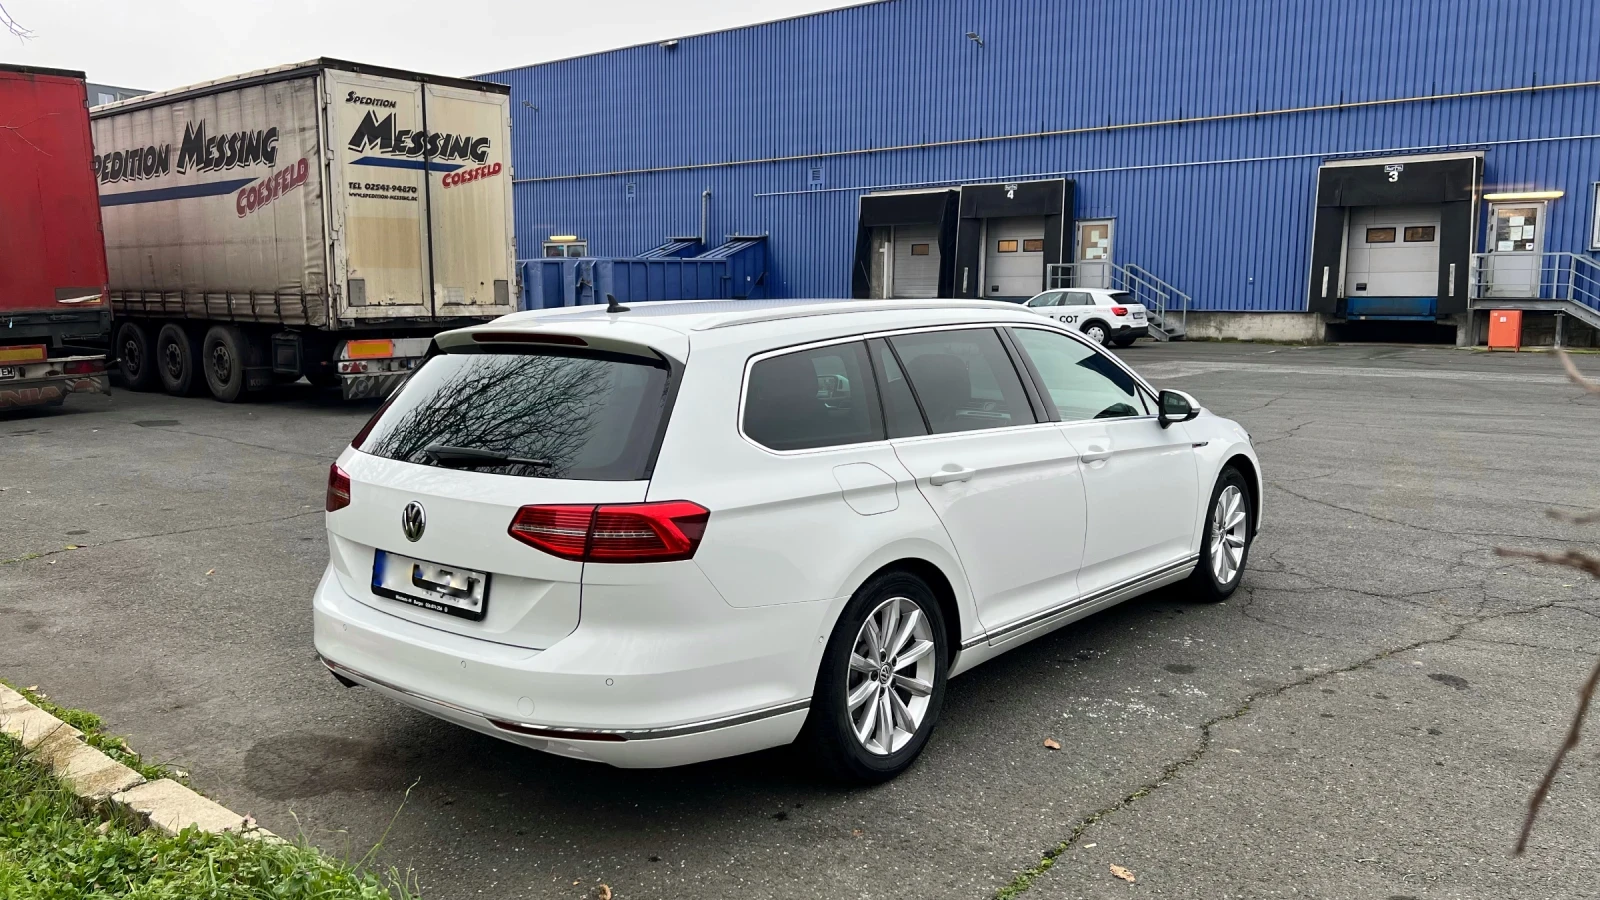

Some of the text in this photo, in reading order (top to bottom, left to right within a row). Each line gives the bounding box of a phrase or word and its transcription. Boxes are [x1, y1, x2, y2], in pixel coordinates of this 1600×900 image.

[346, 91, 397, 108] SPEDITION
[177, 118, 279, 175] MESSING
[348, 109, 490, 165] MESSING
[348, 182, 362, 190] TEL
[441, 162, 502, 189] COESFELD
[1388, 171, 1398, 182] 3
[236, 157, 310, 218] COESFELD
[1007, 190, 1014, 199] 4
